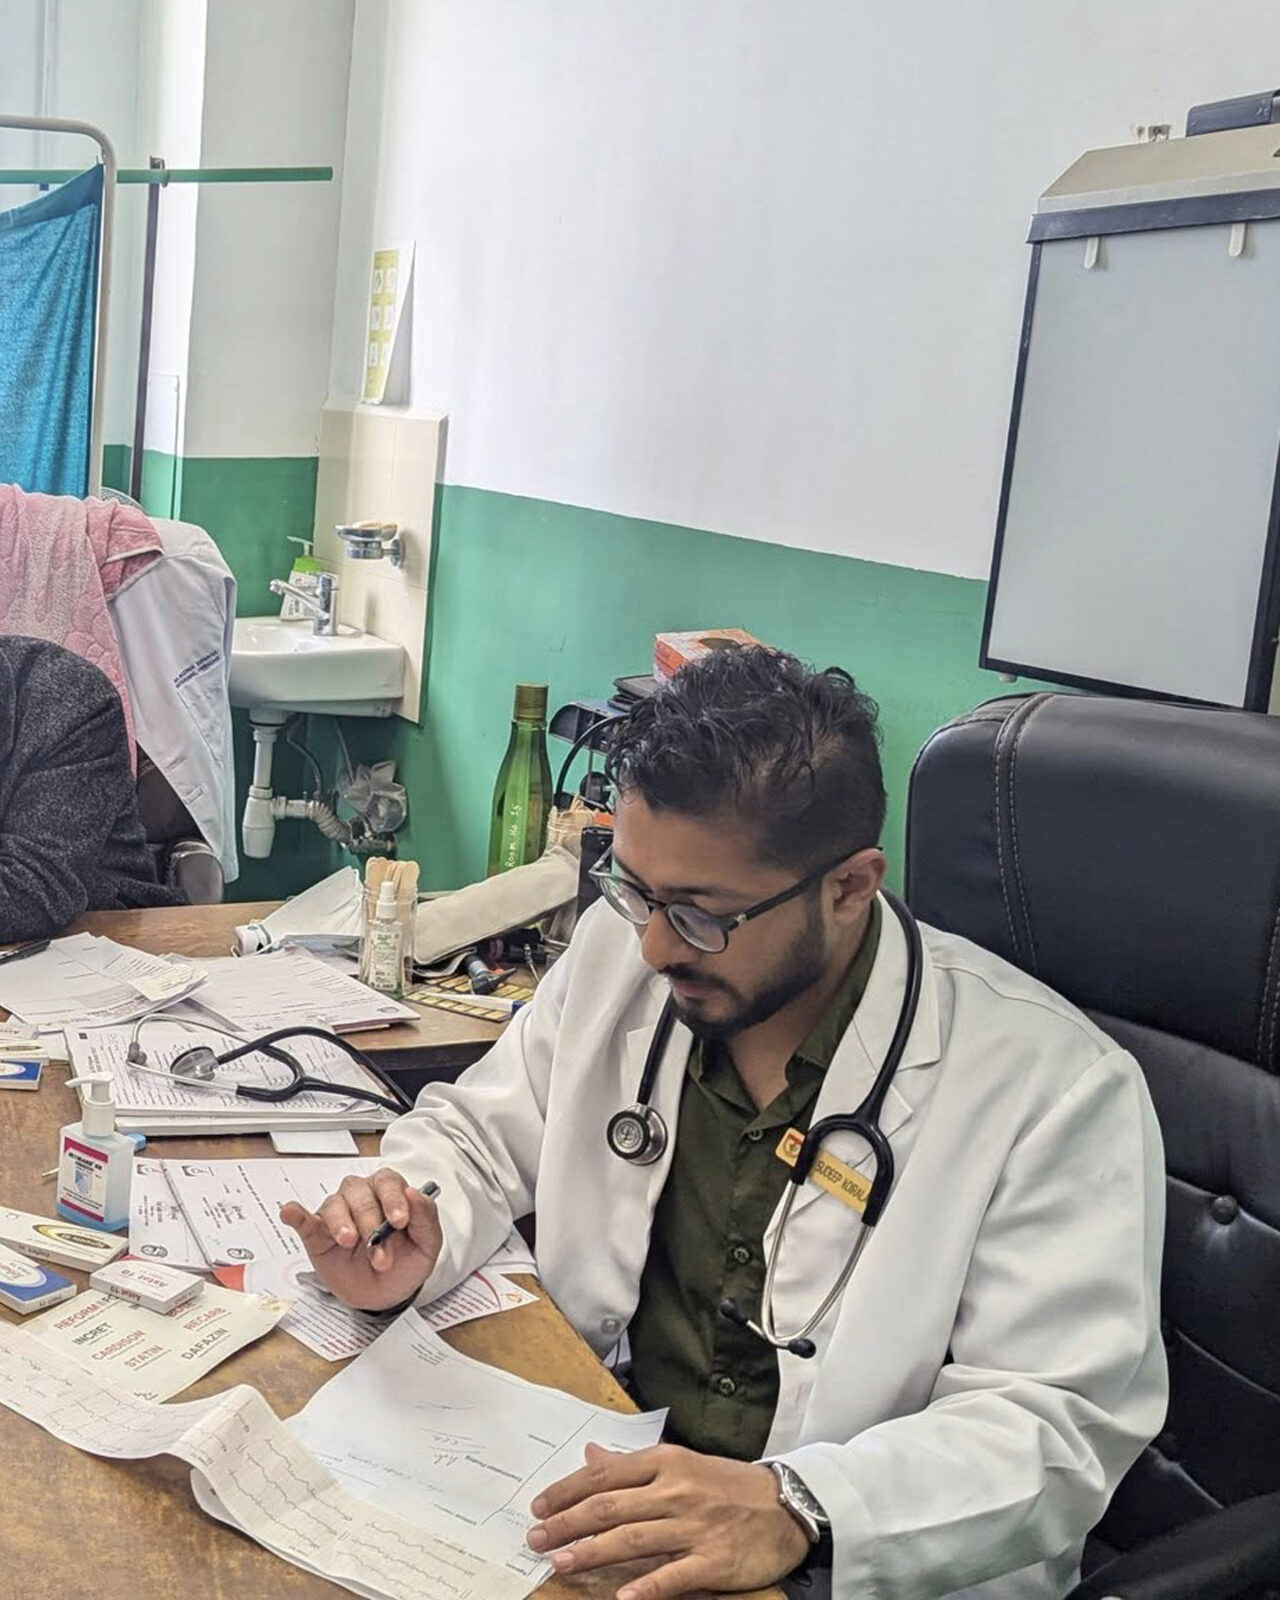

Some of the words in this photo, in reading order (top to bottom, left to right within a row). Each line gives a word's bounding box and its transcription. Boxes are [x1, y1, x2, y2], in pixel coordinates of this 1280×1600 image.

[53, 1303, 100, 1332] REFORM
[72, 1321, 113, 1347] INCRET
[180, 1326, 229, 1361] DAFAZIN
[123, 1345, 164, 1369] STATIN
